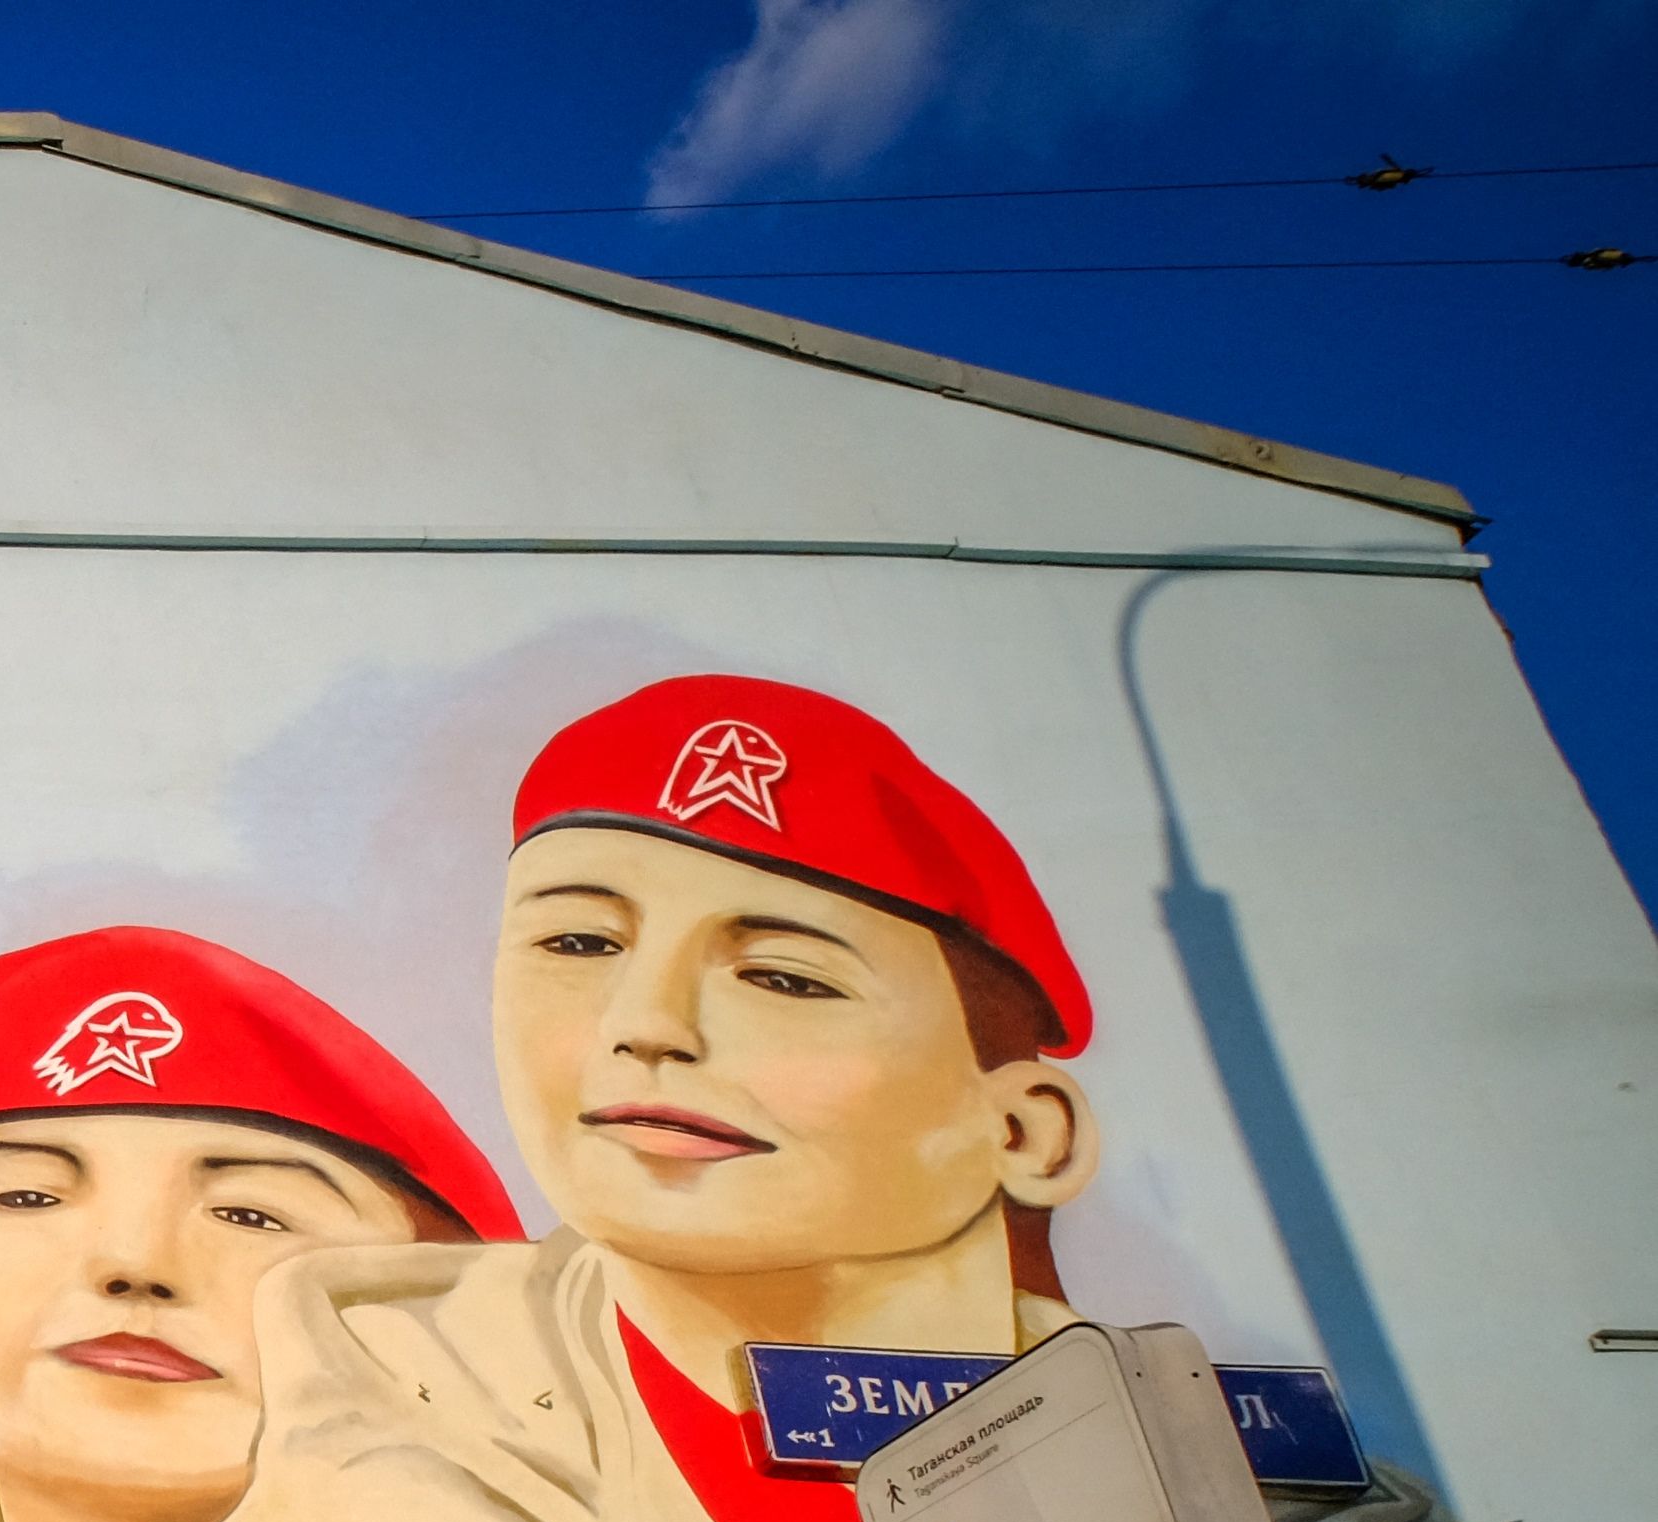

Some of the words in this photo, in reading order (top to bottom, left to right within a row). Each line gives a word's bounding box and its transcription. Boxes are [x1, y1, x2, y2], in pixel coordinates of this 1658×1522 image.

[818, 1428, 835, 1447] 1
[908, 1435, 976, 1481] Таганская
[979, 1395, 1045, 1441] площадь
